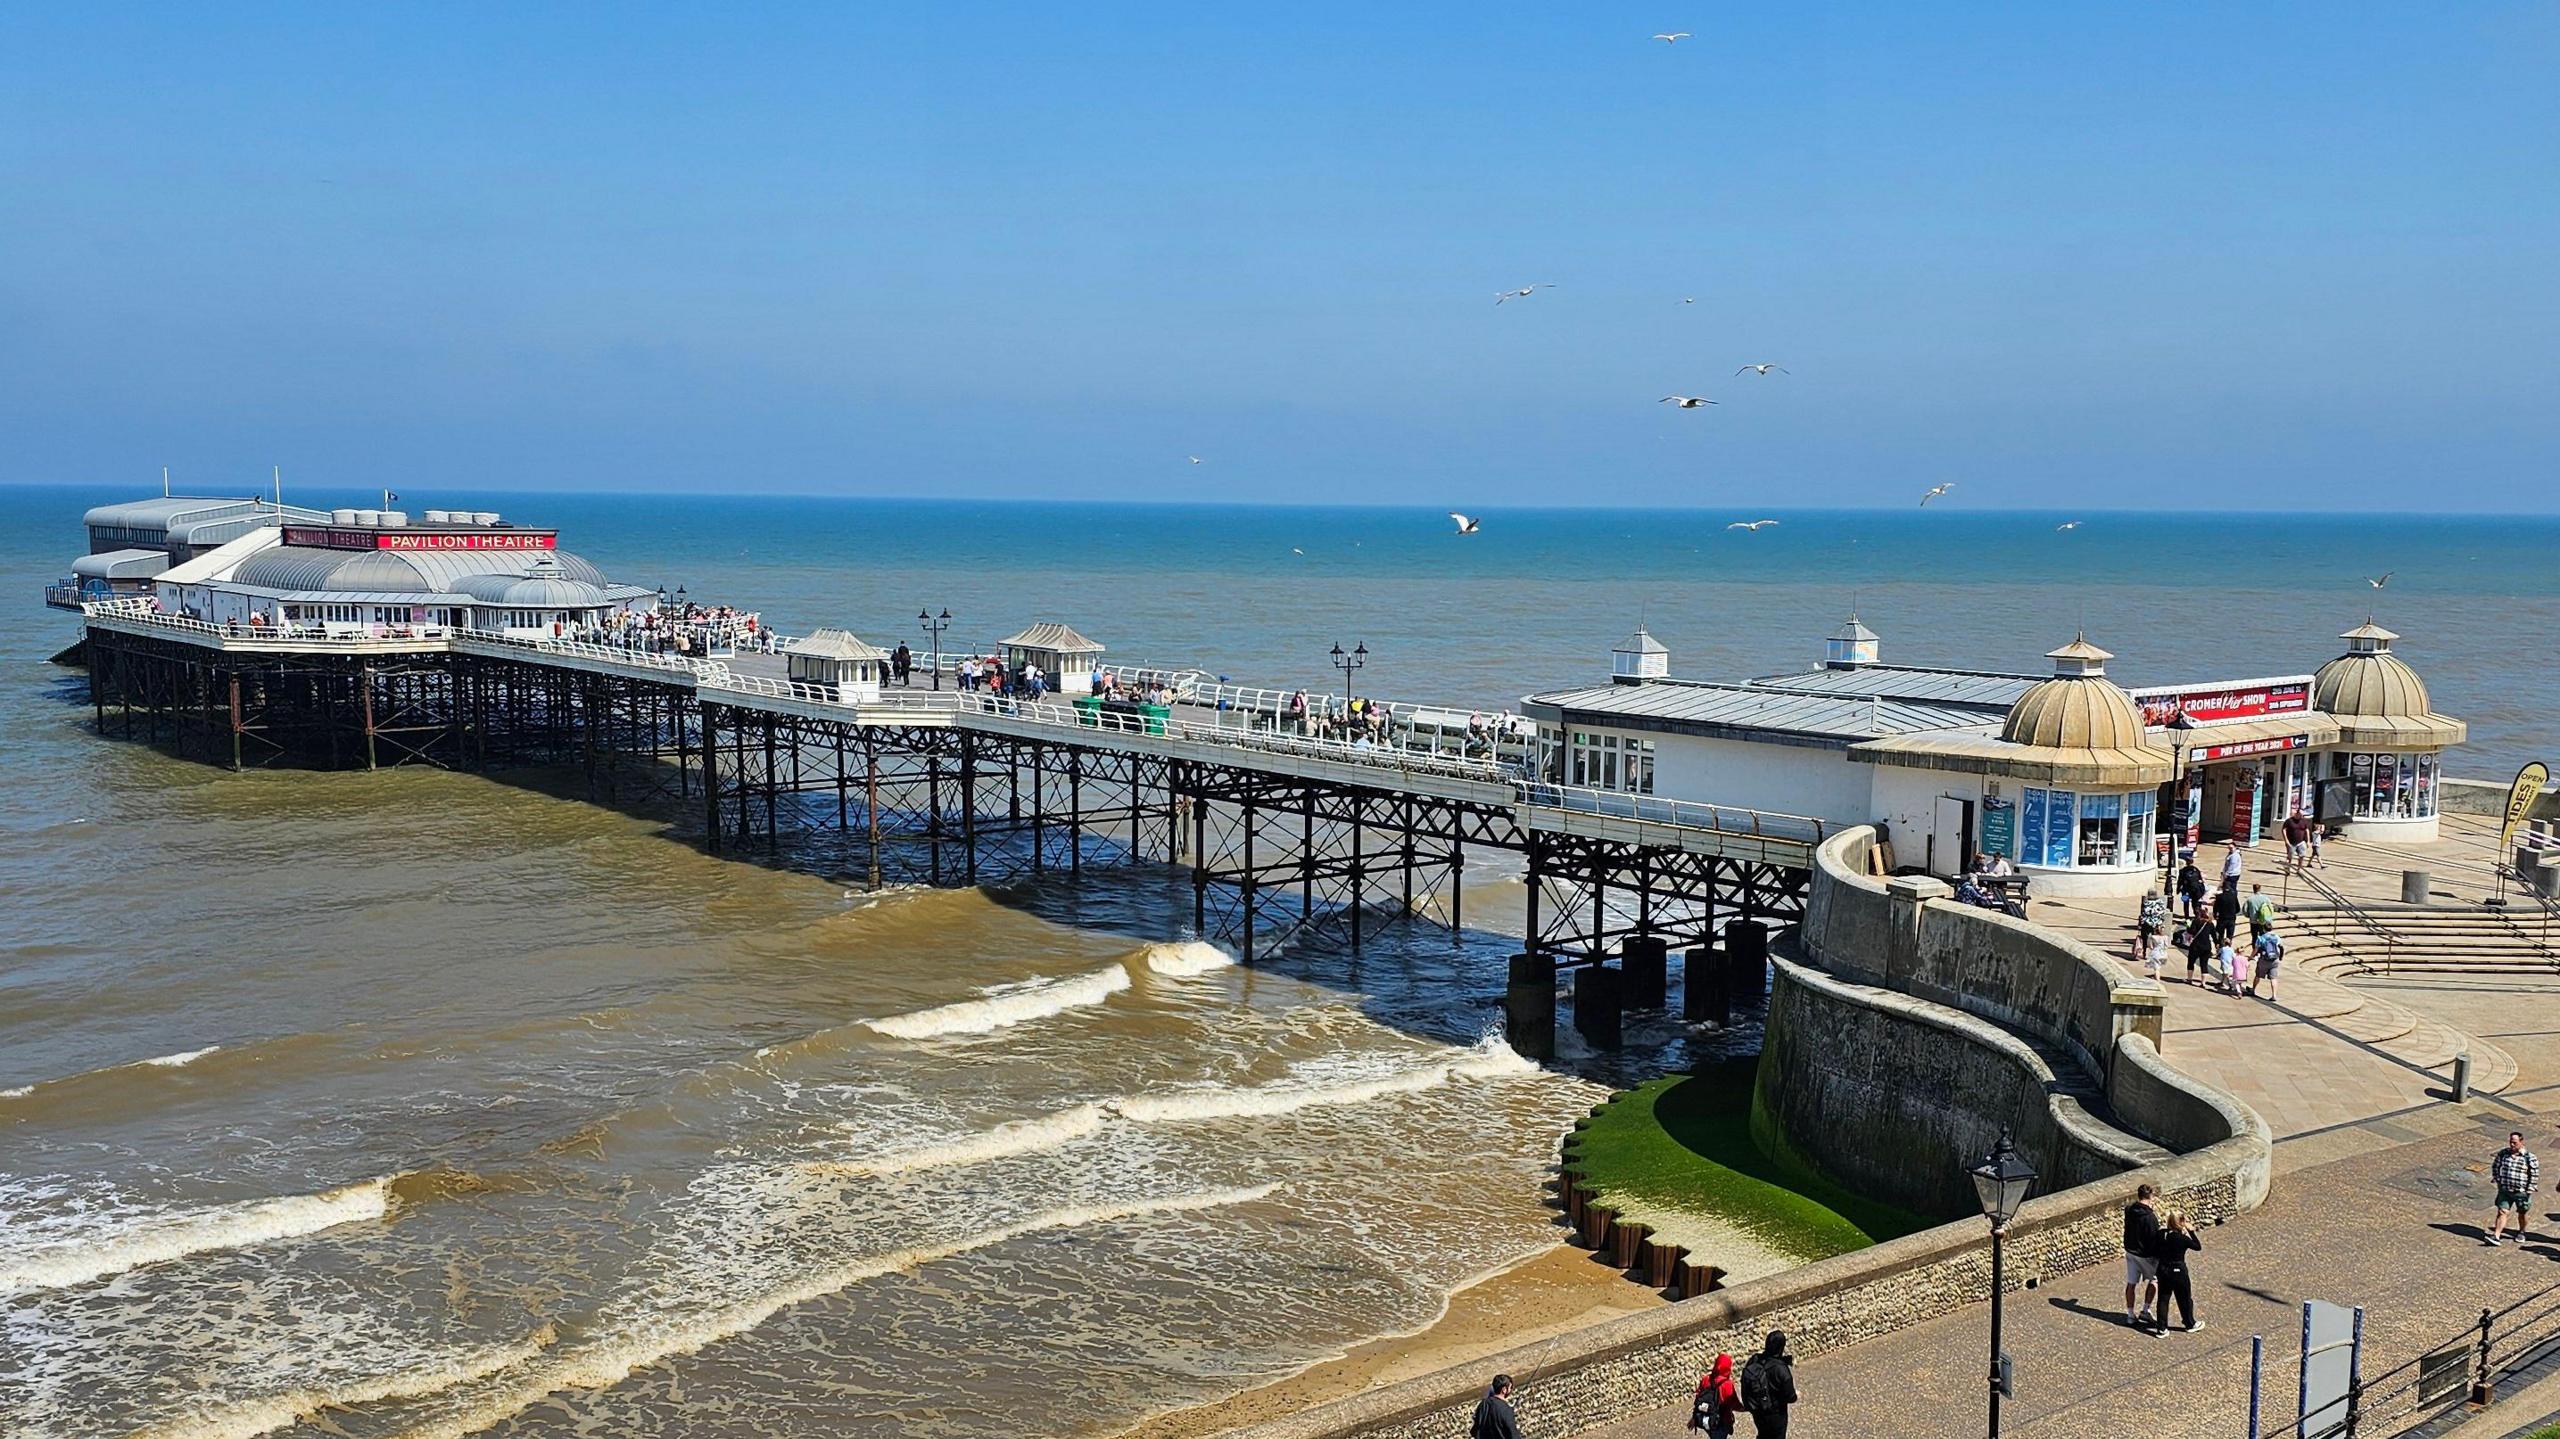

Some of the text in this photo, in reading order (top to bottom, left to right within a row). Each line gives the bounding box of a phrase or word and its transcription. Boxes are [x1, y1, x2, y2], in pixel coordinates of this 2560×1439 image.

[292, 530, 371, 547] PAVILION THEATRE
[391, 536, 545, 548] PAVILION THEATRE
[2185, 691, 2266, 711] CROMER Pier SHOW
[2220, 747, 2234, 757] PIER
[2255, 742, 2269, 752] YEAR
[2521, 773, 2545, 783] OPEN
